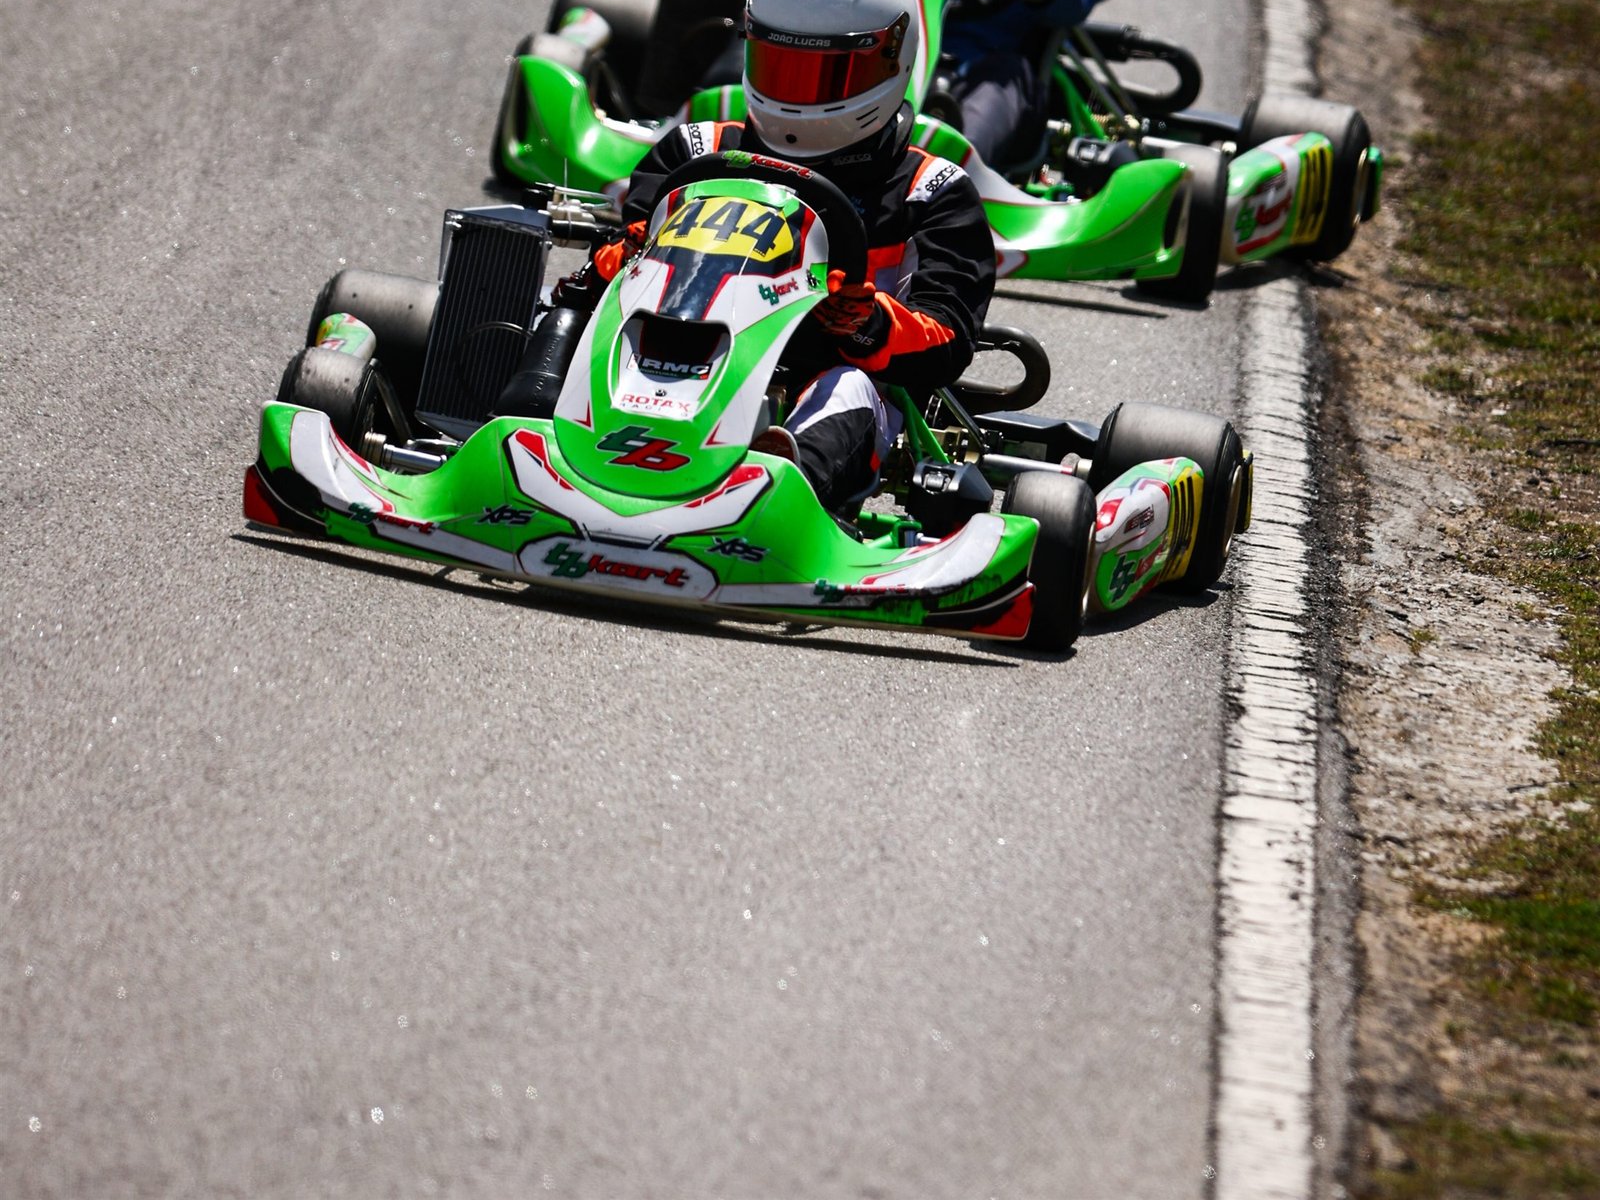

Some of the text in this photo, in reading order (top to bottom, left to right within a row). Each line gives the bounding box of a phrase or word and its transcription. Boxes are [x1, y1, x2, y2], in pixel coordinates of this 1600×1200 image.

[795, 38, 831, 47] LUCAS
[662, 200, 786, 257] 444
[621, 393, 690, 412] ROTAX
